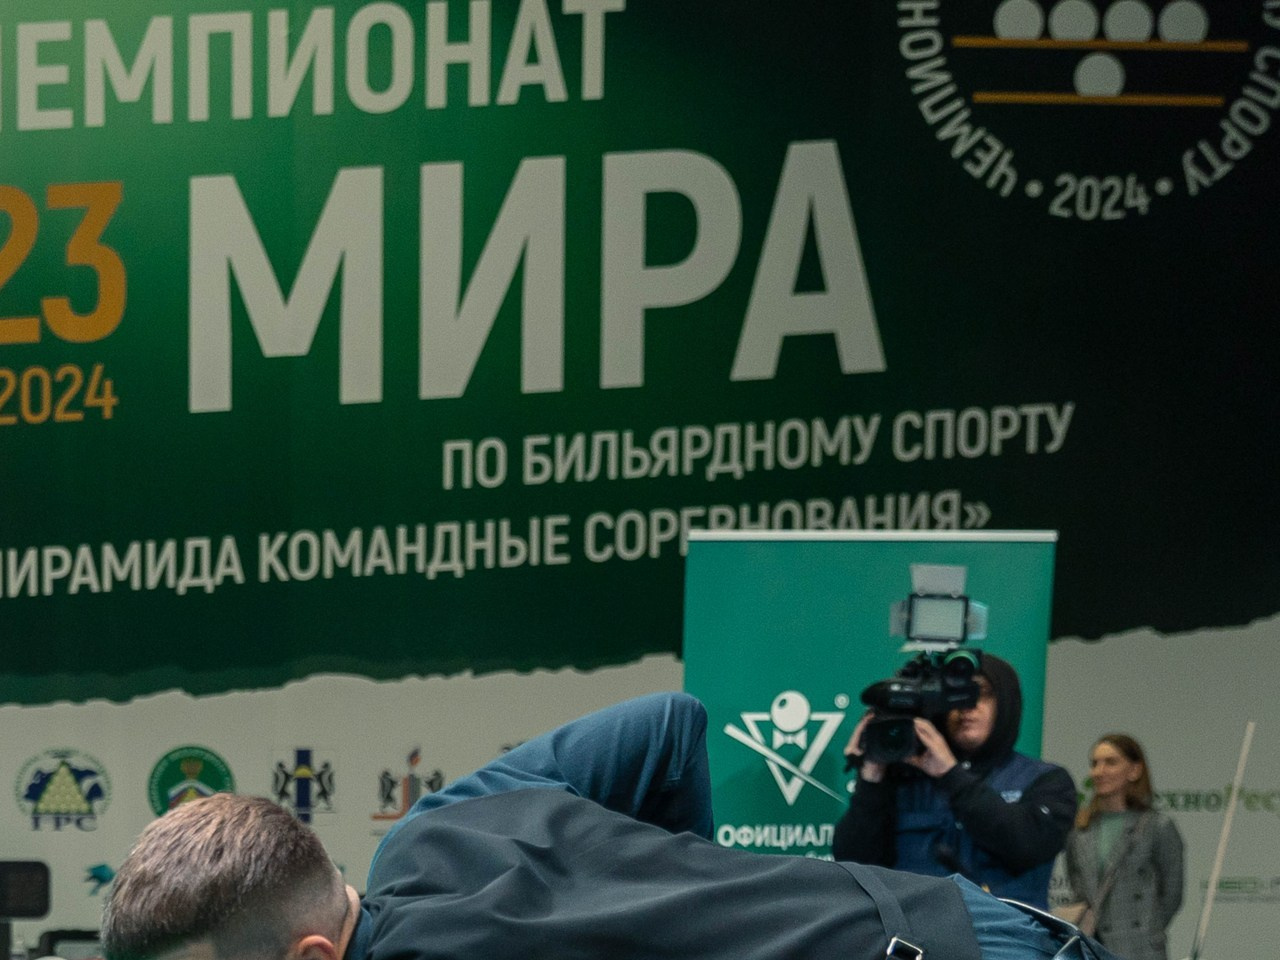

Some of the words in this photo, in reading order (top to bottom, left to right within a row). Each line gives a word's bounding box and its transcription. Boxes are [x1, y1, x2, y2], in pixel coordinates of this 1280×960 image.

[1048, 172, 1151, 221] 2024
[188, 139, 887, 414] МИРА
[442, 437, 508, 490] ПО
[522, 414, 881, 487] БИЛЬЯРДНОМУ
[892, 402, 1075, 462] СПОРТУ
[258, 514, 571, 581] КОМАНДНЫЕ
